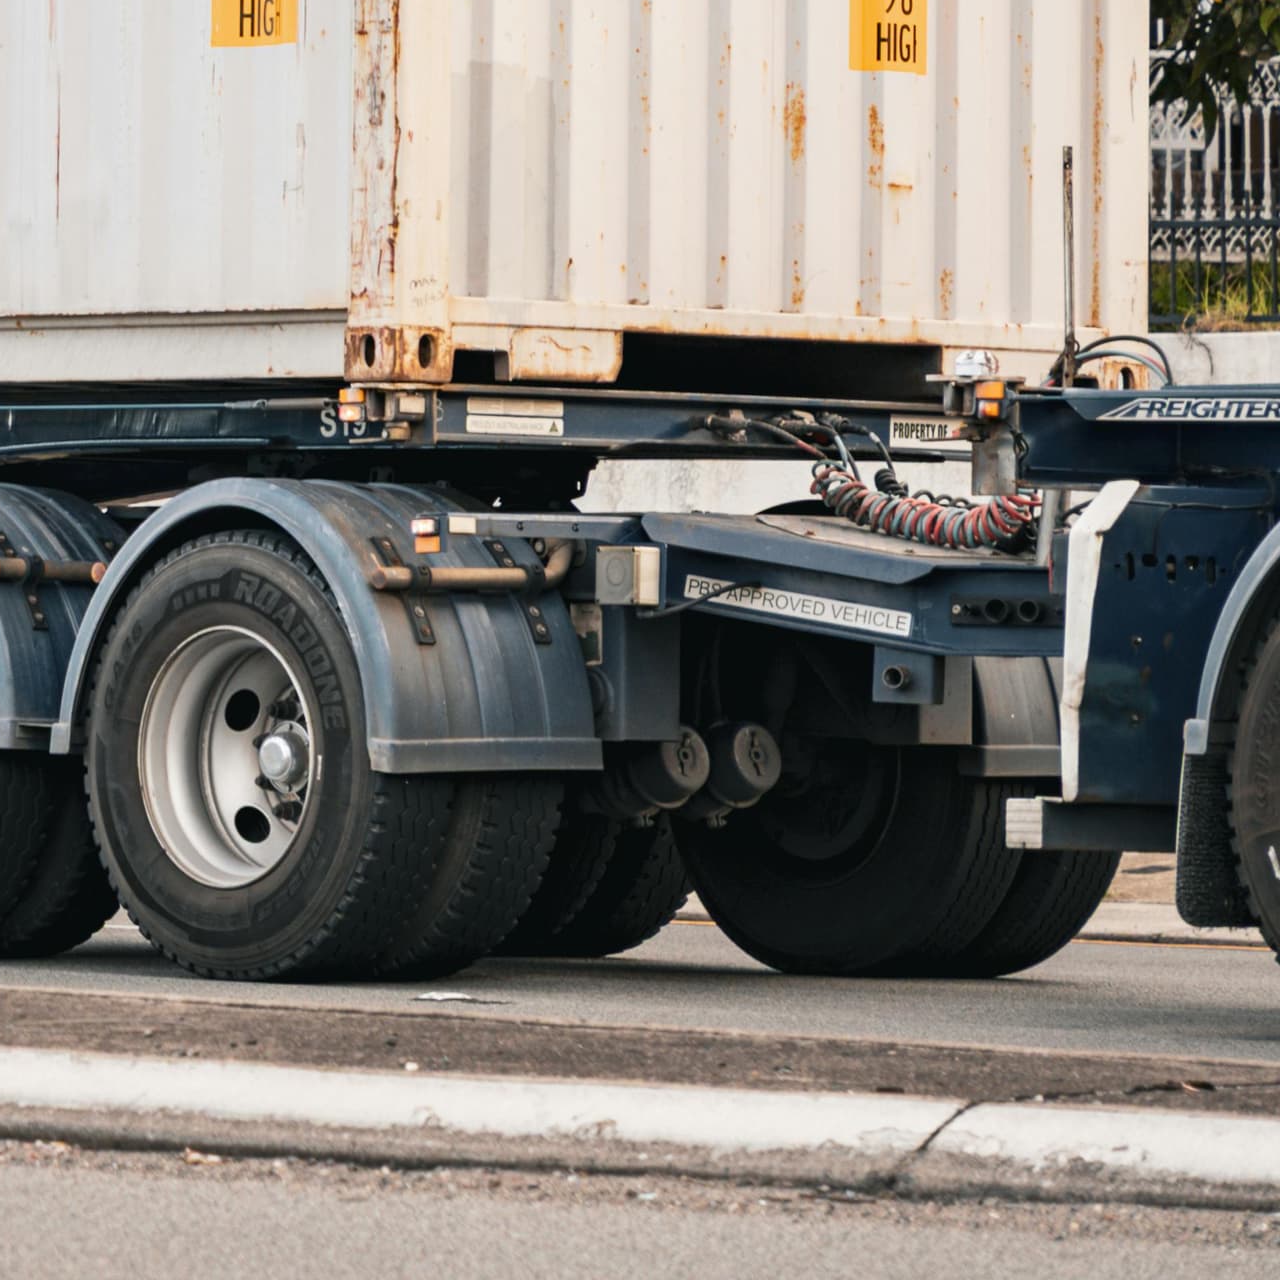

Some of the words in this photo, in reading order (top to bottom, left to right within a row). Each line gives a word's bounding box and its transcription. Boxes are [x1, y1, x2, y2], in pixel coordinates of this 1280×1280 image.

[893, 422, 936, 439] PROPERTY
[938, 423, 948, 439] OF
[726, 587, 826, 617] APPROVED
[831, 603, 908, 632] VEHICLE
